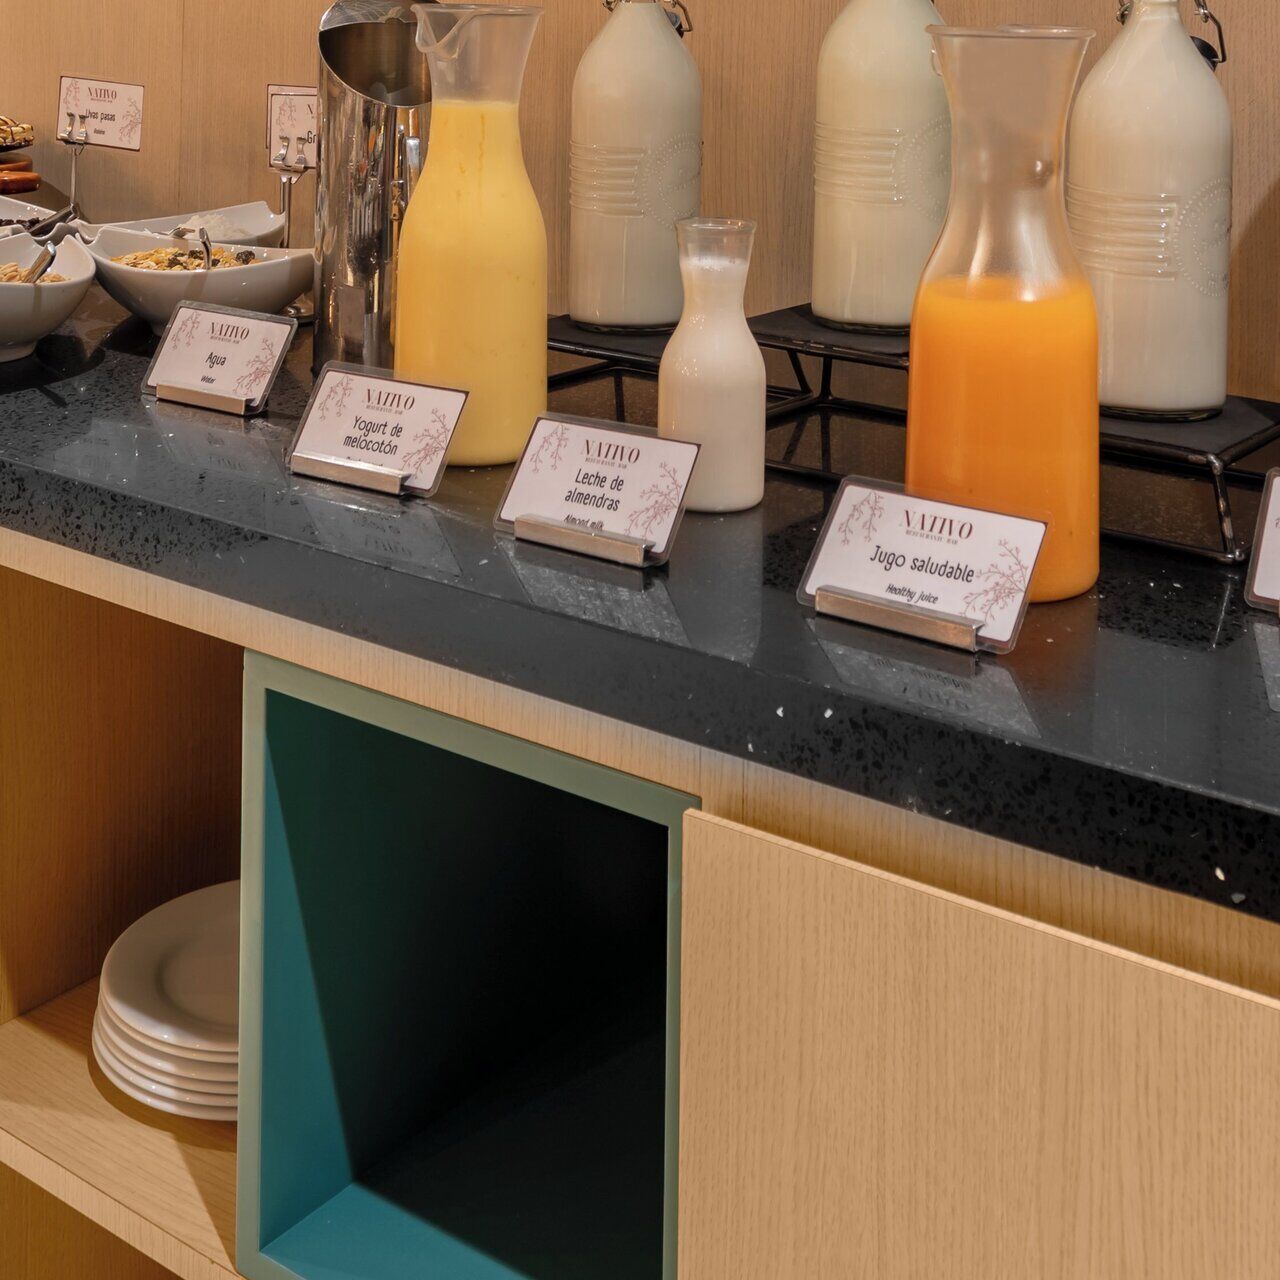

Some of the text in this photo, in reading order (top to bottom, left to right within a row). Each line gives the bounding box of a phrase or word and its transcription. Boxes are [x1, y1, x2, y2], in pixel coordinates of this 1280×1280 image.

[87, 86, 118, 100] NATIVO
[100, 111, 116, 123] pasas
[207, 321, 250, 340] NATIVO
[205, 351, 227, 369] Agua
[200, 375, 217, 384] Water
[361, 388, 416, 411] NATIVO
[352, 415, 403, 438] Yogurt de
[342, 435, 398, 456] melocotón
[581, 439, 641, 465] NATIVO
[575, 468, 625, 492] Leche de
[564, 488, 621, 512] almendras
[564, 514, 605, 531] Almond milk
[899, 509, 974, 541] NATIVO
[870, 545, 976, 583] Jugo saludable
[885, 583, 939, 605] Healthy juice
